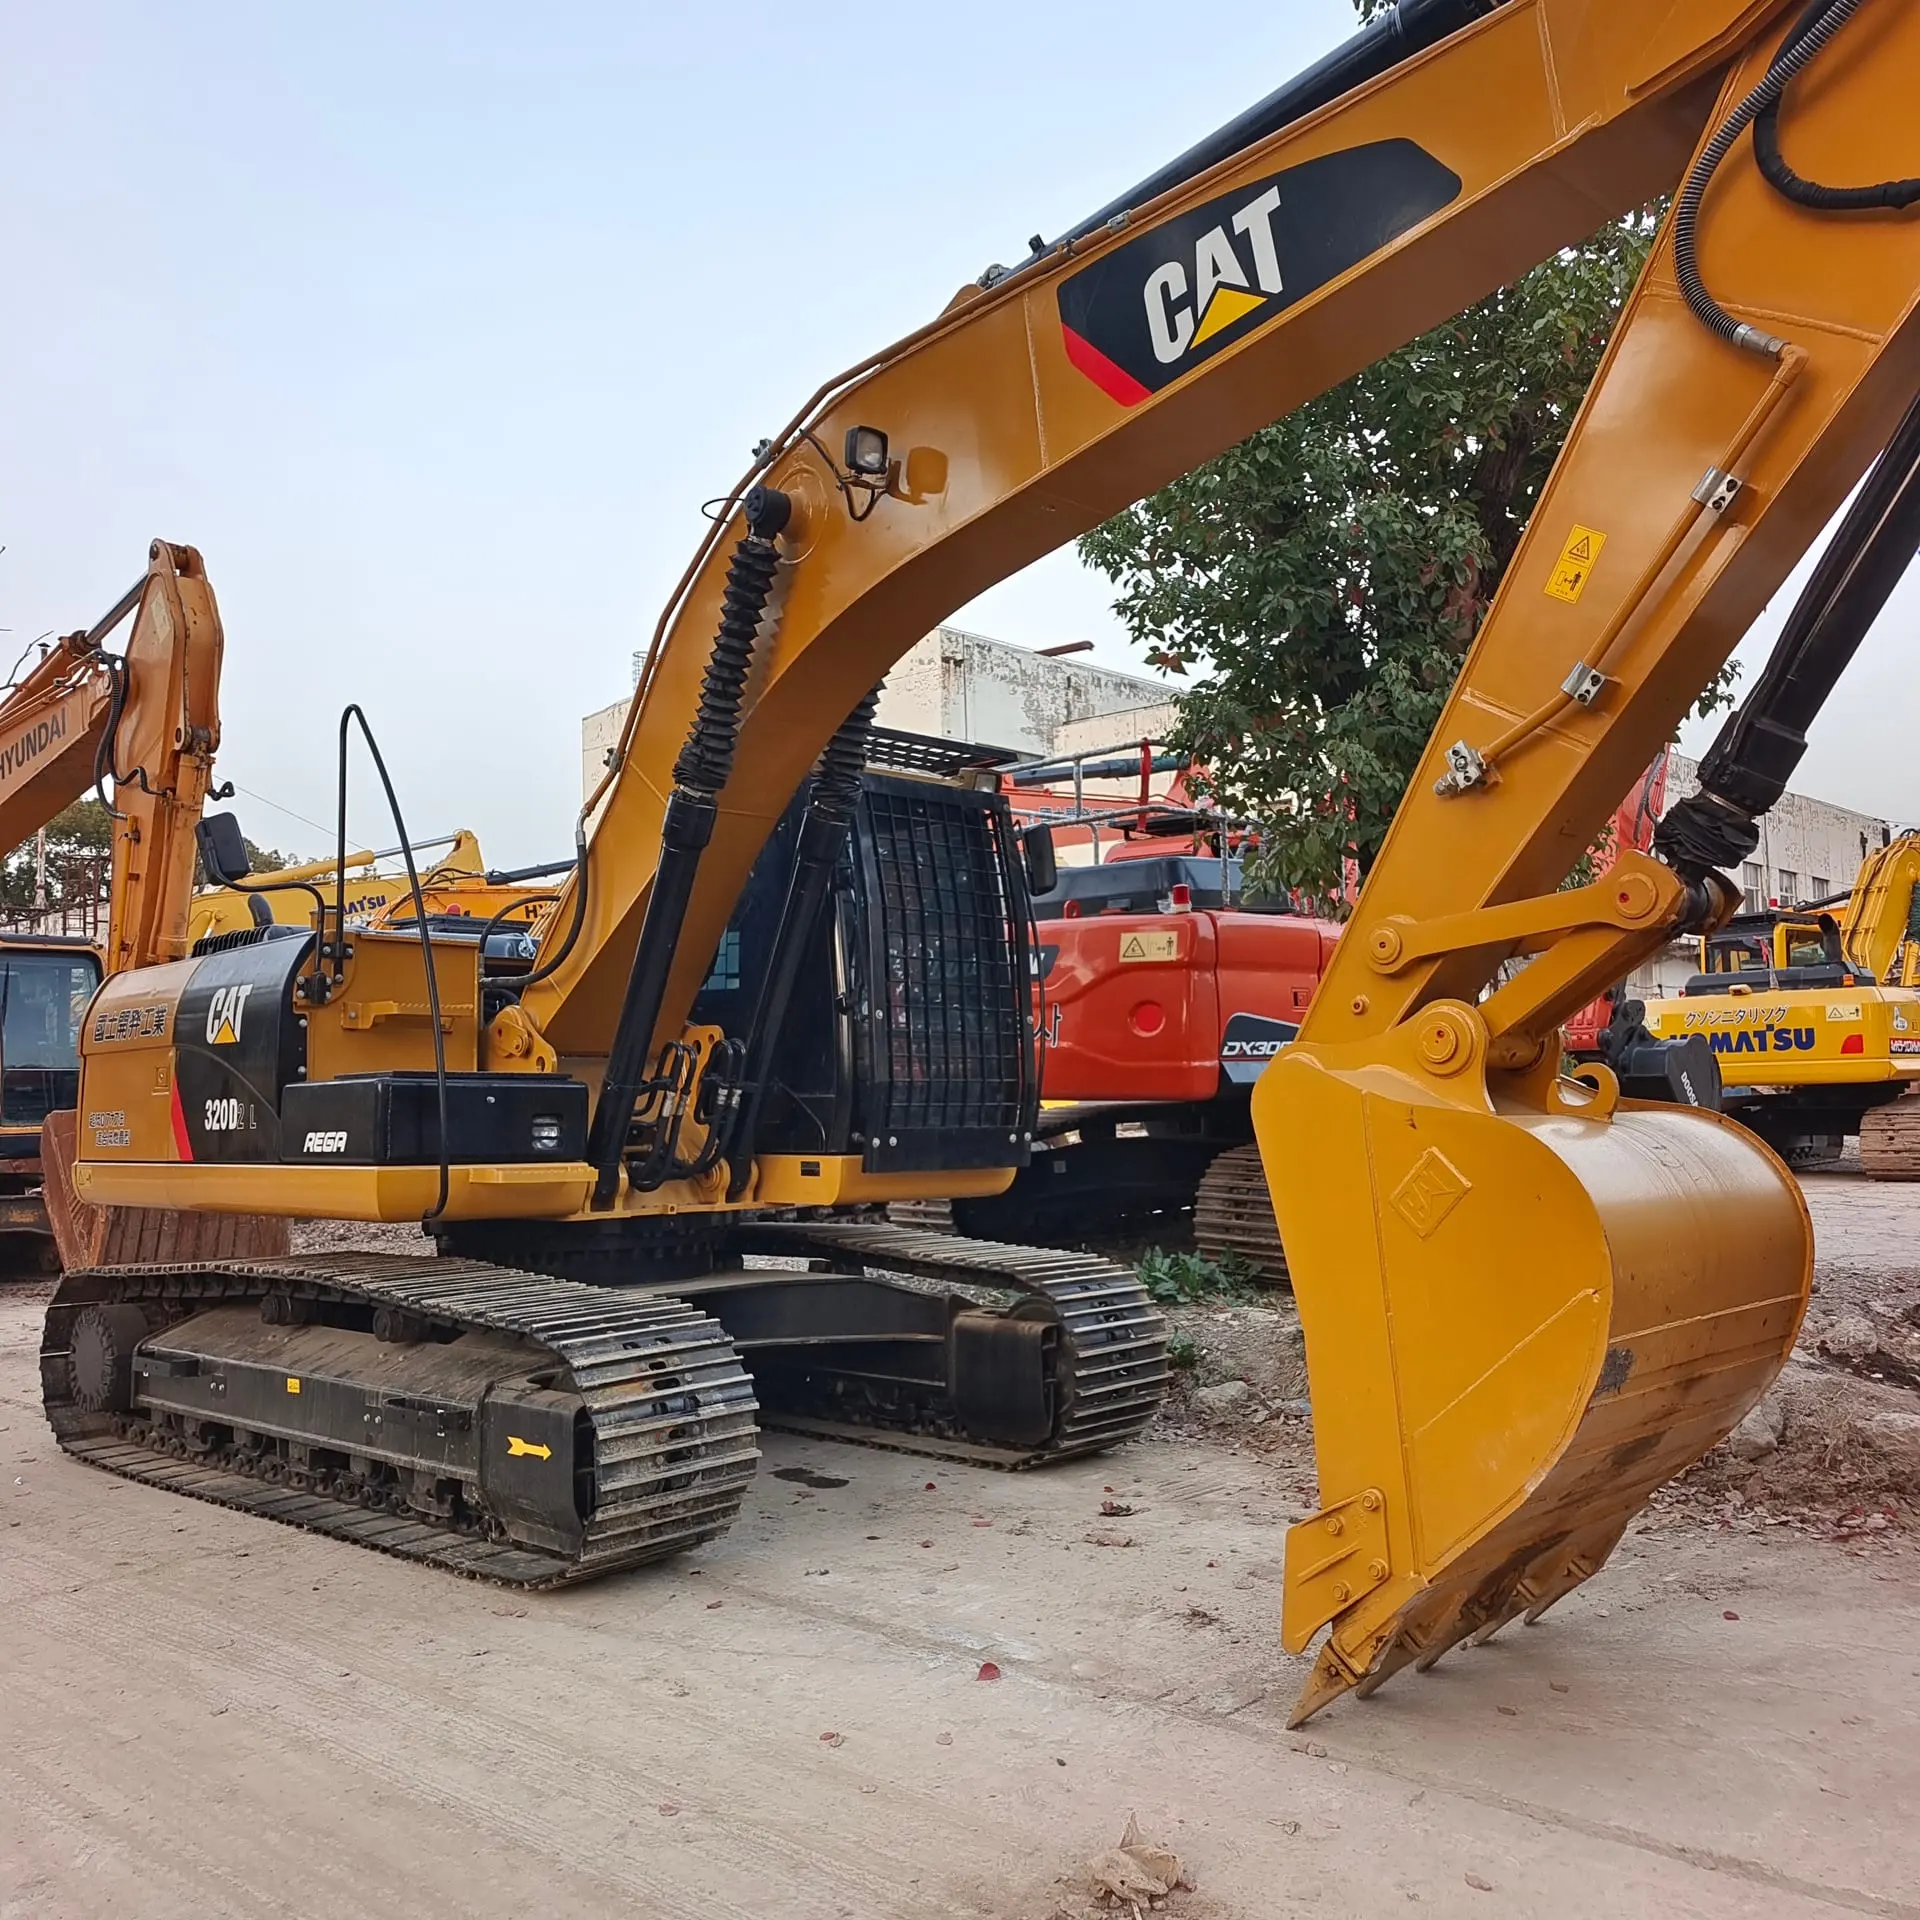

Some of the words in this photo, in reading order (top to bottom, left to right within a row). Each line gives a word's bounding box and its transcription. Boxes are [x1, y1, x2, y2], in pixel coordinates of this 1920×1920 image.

[1143, 185, 1283, 364] CAT
[343, 894, 387, 914] ATSU
[206, 983, 254, 1045] CAT
[1221, 1040, 1295, 1057] DX30
[1670, 1023, 1816, 1054] MATSU
